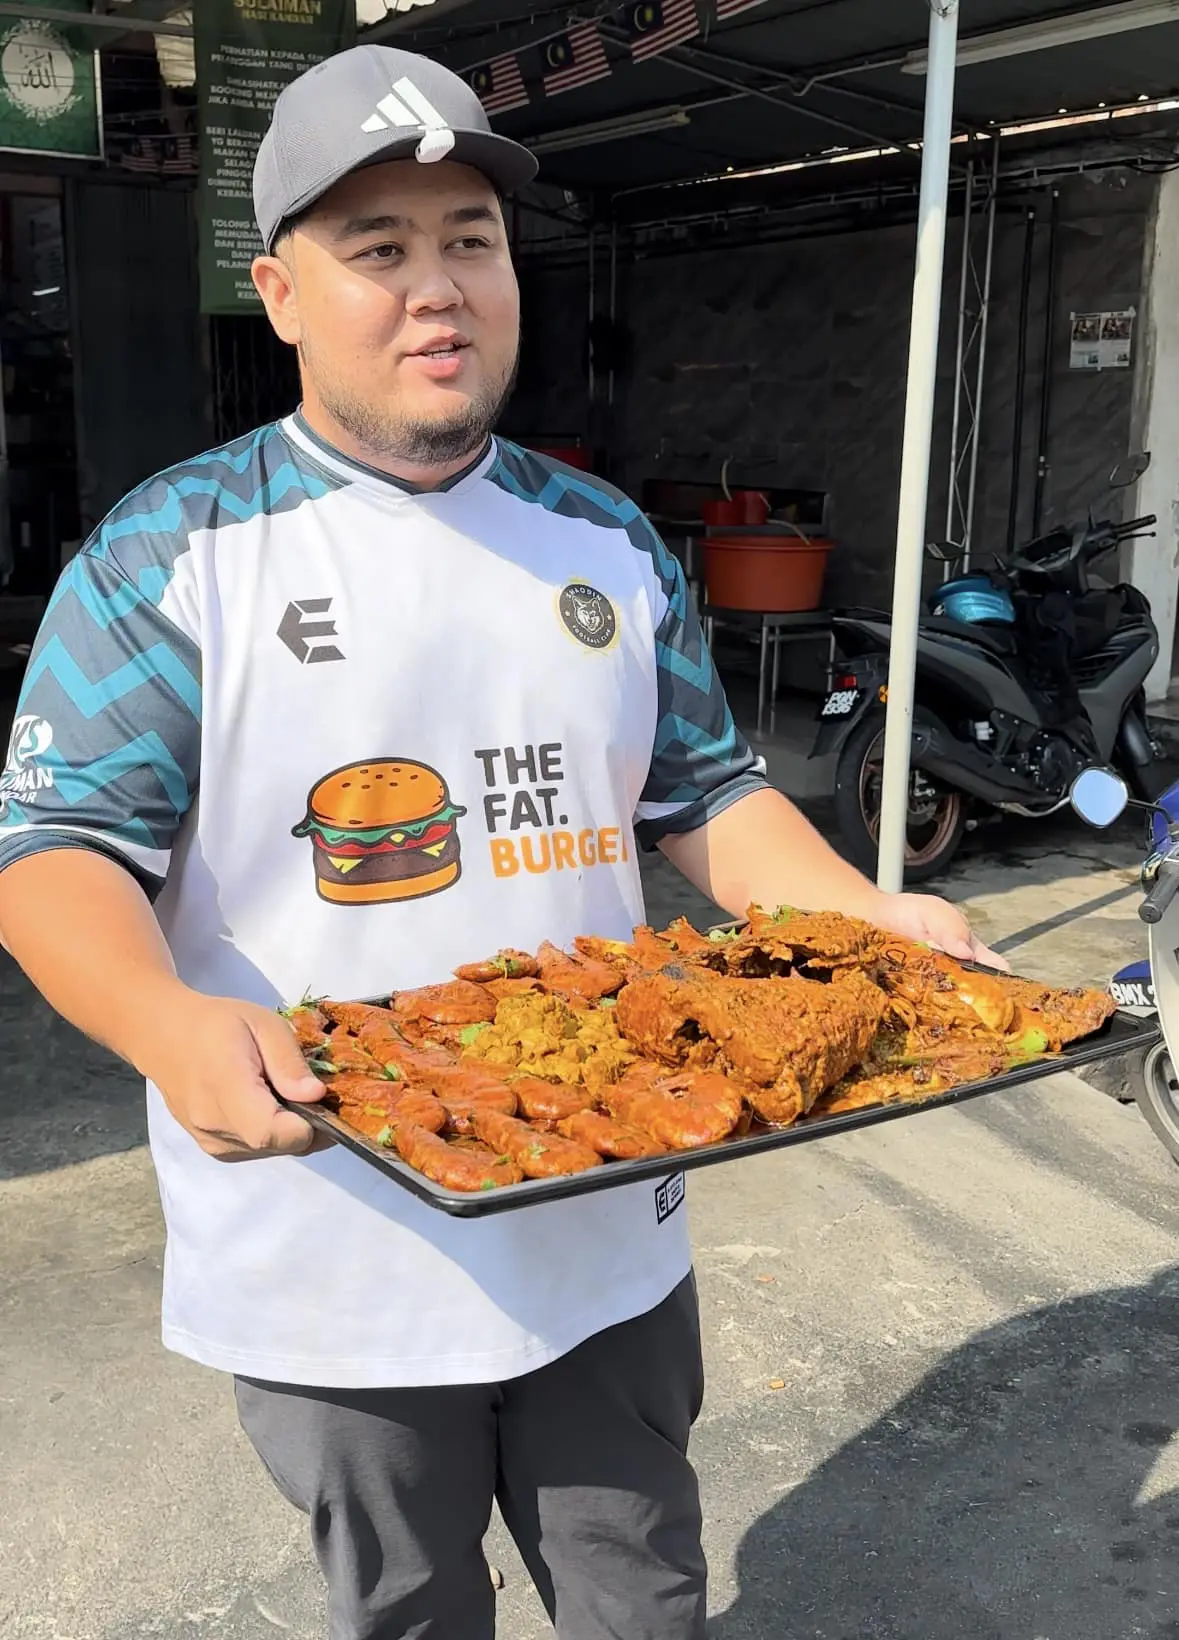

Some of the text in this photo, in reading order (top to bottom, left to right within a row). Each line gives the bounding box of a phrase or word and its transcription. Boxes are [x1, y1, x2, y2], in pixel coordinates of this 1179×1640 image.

[270, 48, 305, 60] KEPADA
[269, 60, 294, 70] YANG
[205, 126, 226, 135] BERI
[213, 148, 248, 158] MAKAN
[212, 218, 250, 229] TOLONG
[215, 230, 262, 240] MEMUDAH
[214, 239, 235, 248] DAN
[474, 742, 565, 788] THE
[484, 787, 569, 833] FAT.
[489, 827, 628, 878] BURGE
